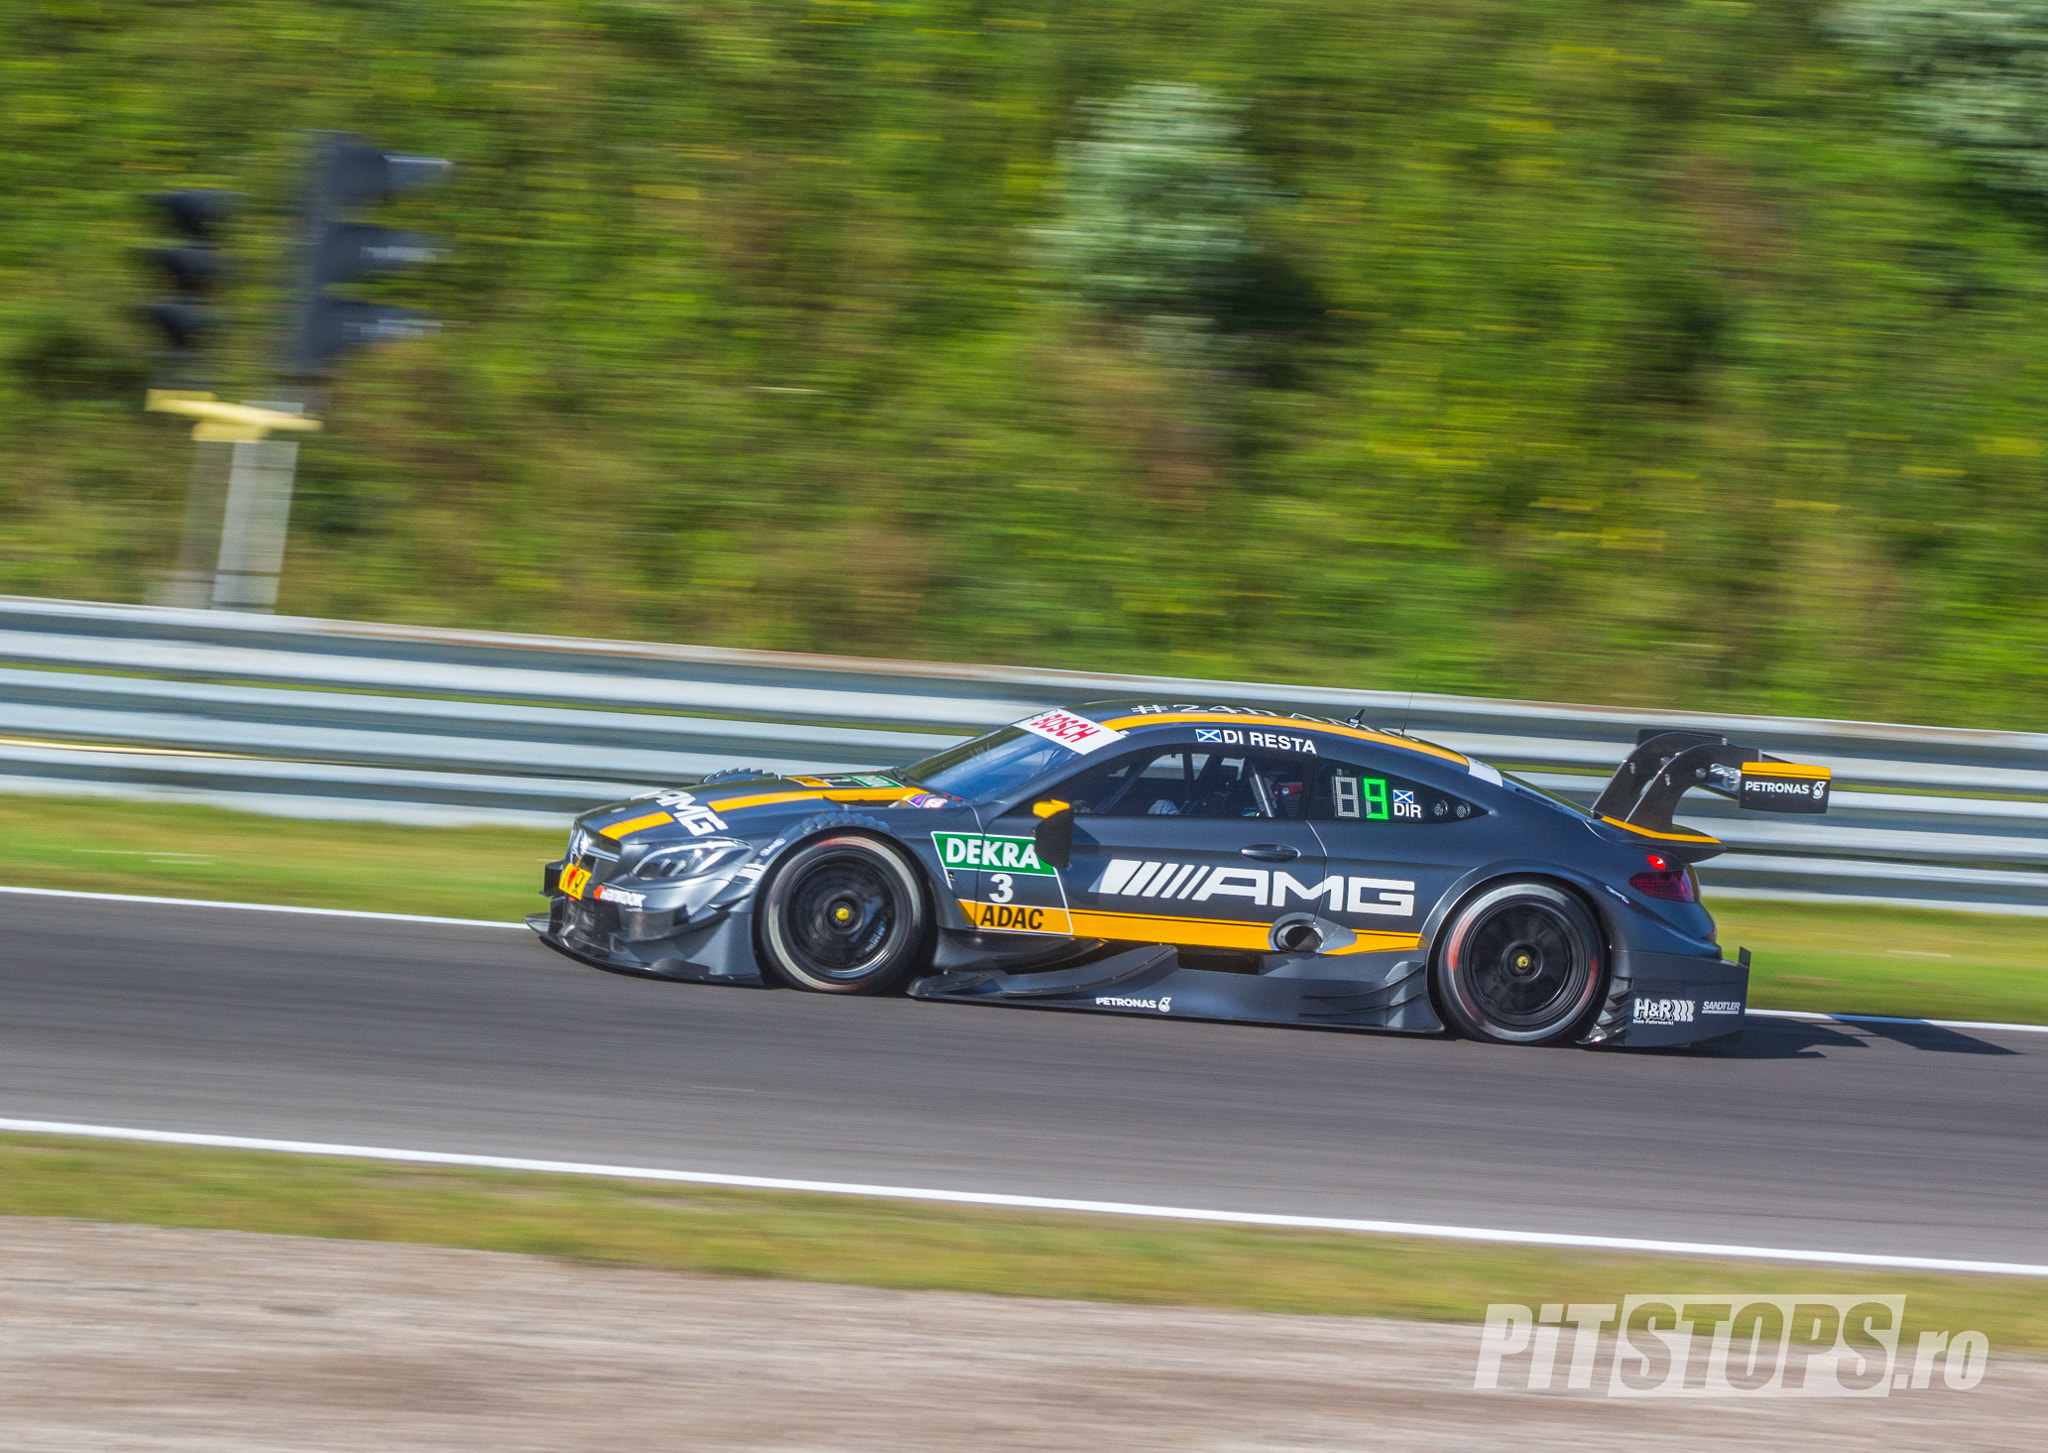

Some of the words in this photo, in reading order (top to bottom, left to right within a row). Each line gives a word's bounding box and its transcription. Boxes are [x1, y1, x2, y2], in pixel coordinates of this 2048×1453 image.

[1030, 713, 1101, 743] BOSCH
[1223, 729, 1244, 745] DI
[1250, 732, 1317, 755] RESTA
[1745, 780, 1810, 795] PETRONAS
[630, 789, 729, 837] AMG
[1394, 802, 1422, 819] DIR
[946, 837, 1041, 870] DEKRA
[988, 873, 1014, 904] 3
[1192, 866, 1415, 917] AMG
[980, 905, 1044, 930] ADAC
[1095, 997, 1157, 1009] PETRONAS
[1633, 998, 1674, 1020] H&R
[1702, 1001, 1741, 1011] SANDTLER
